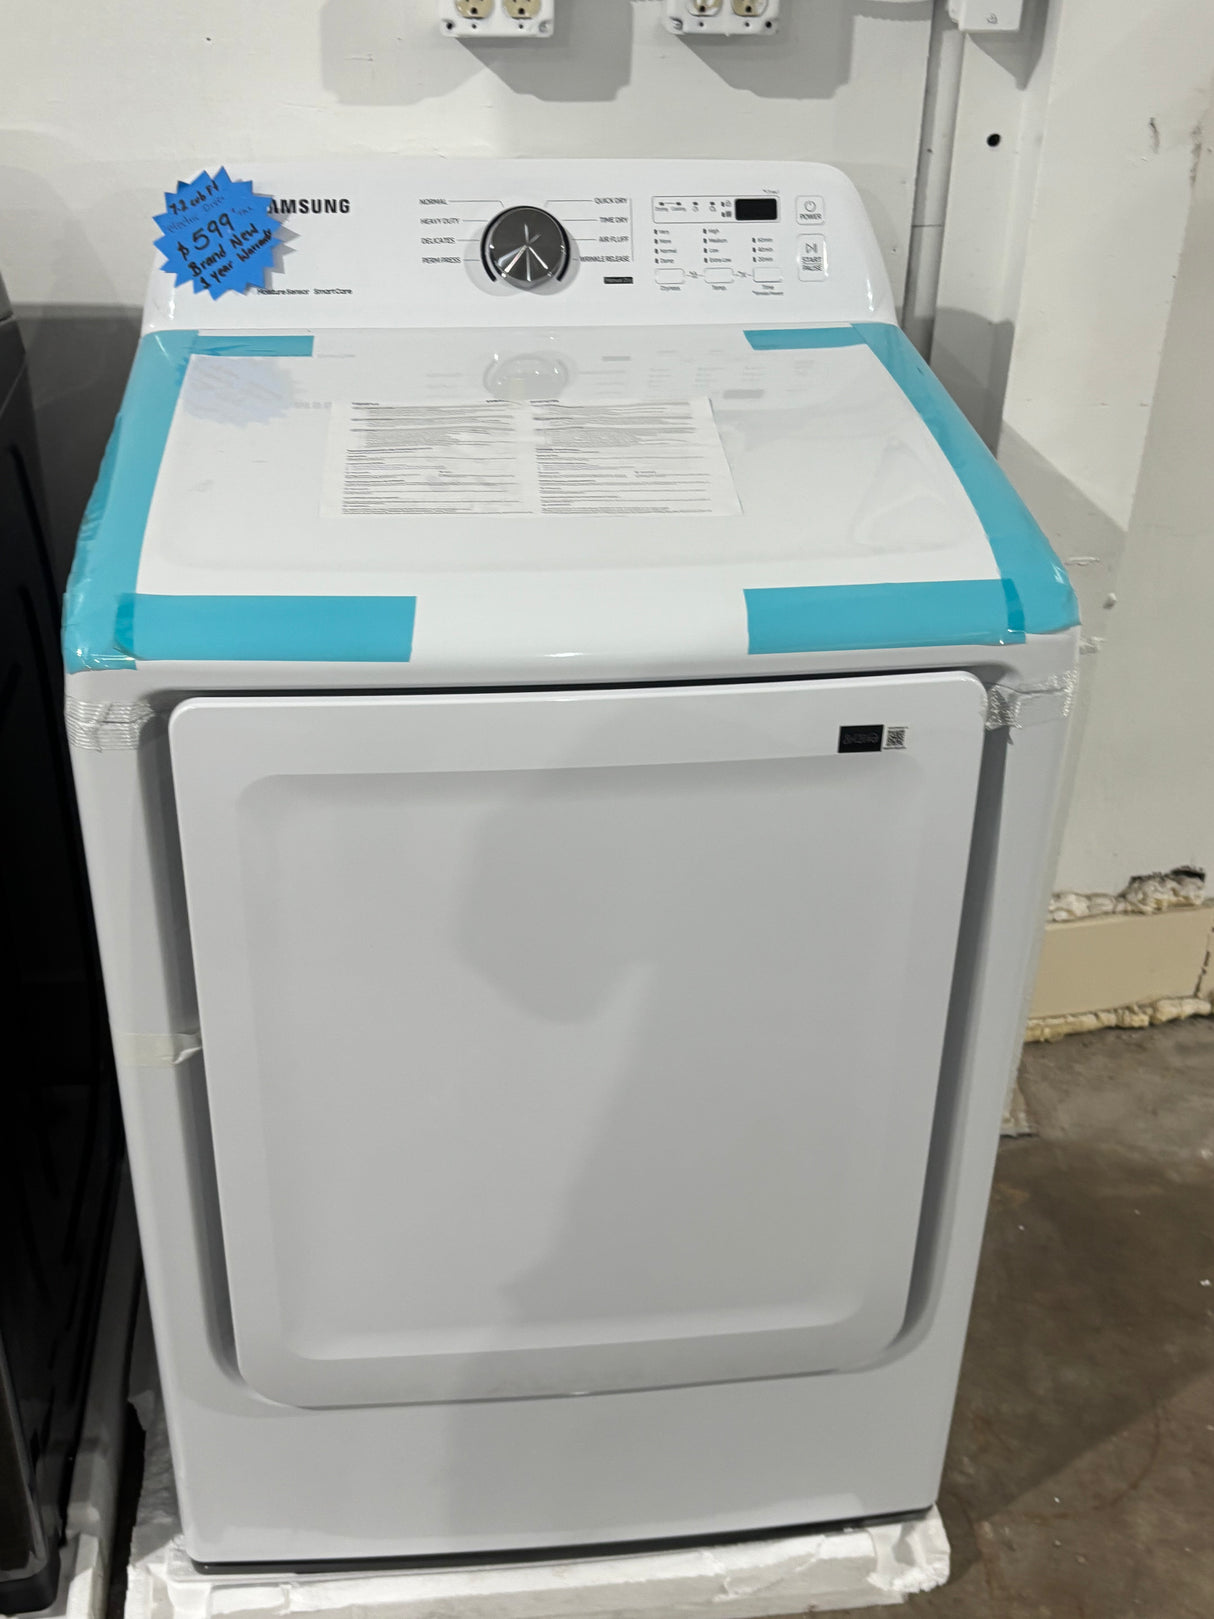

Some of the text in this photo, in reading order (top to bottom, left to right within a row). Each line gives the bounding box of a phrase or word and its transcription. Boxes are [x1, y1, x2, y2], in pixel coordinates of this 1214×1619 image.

[267, 198, 350, 214] AMSUNG
[176, 212, 235, 261] $599
[187, 223, 259, 277] Brand New
